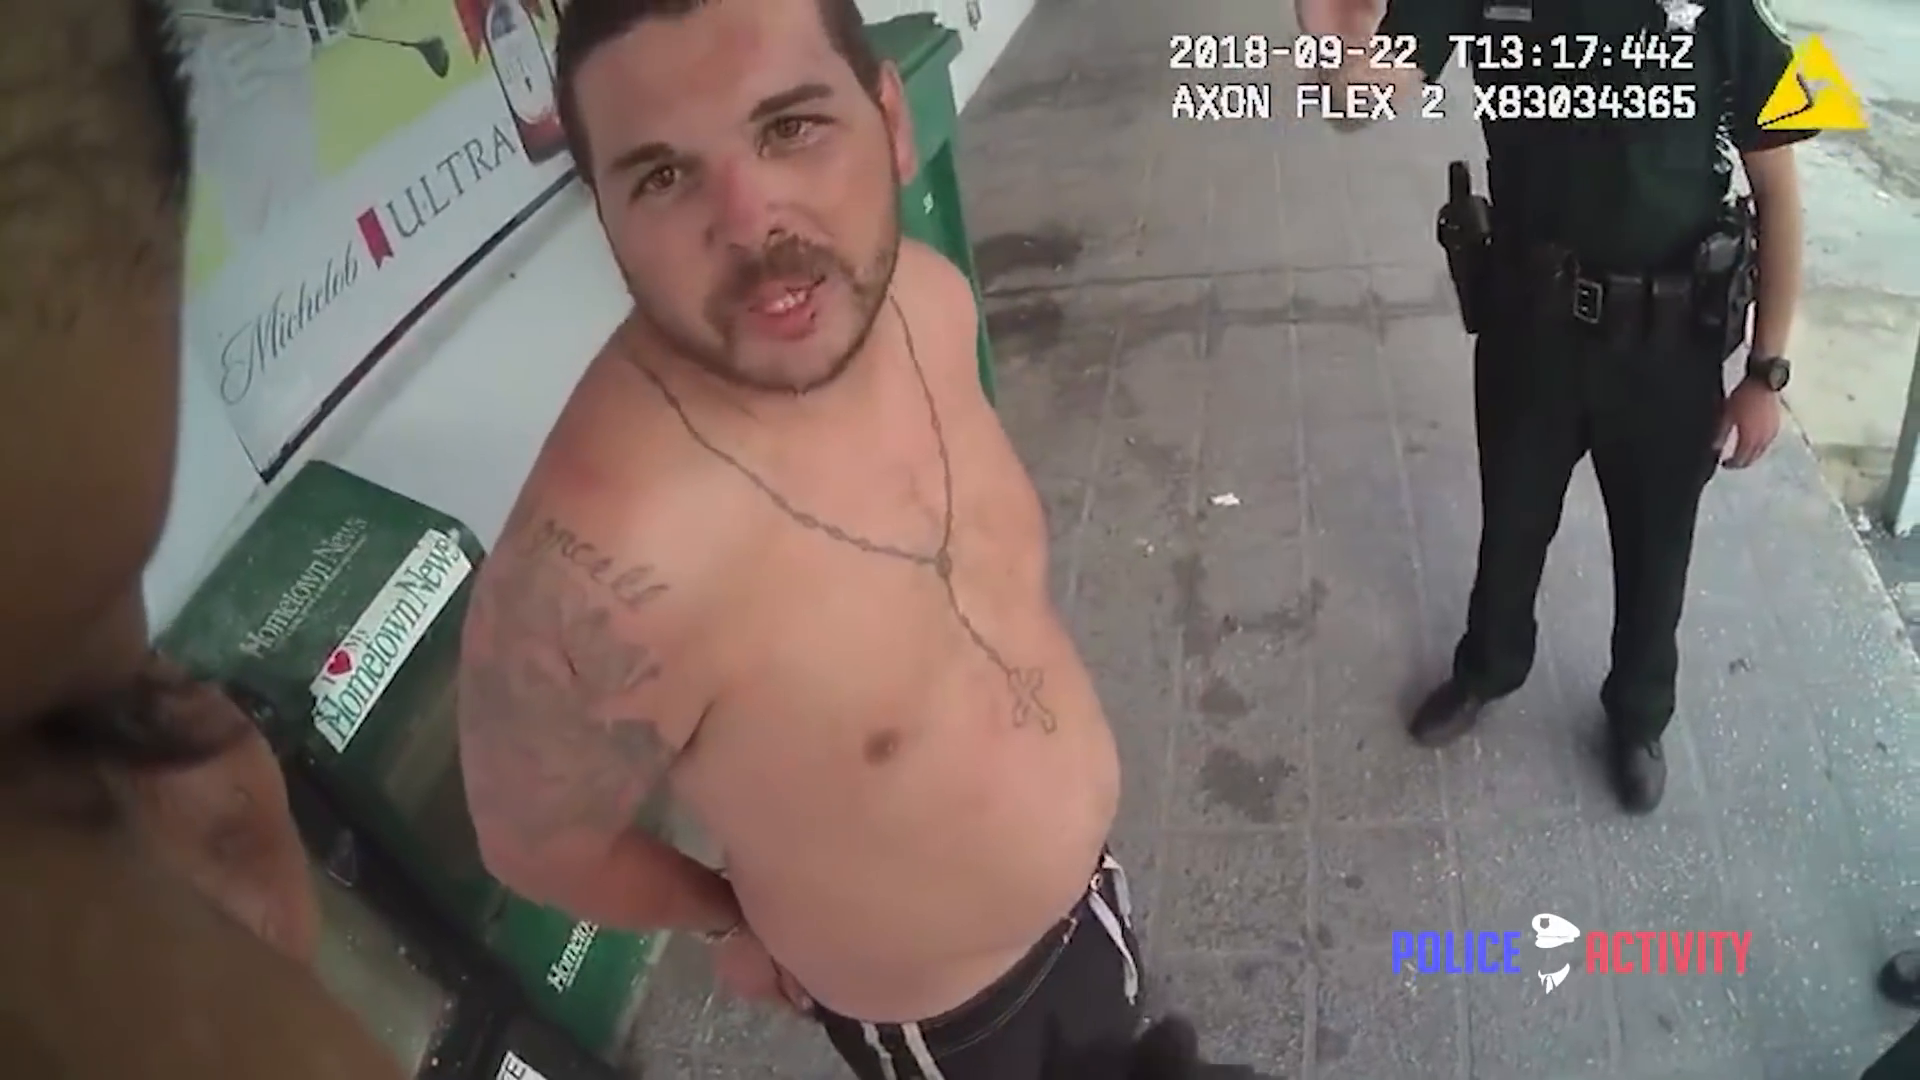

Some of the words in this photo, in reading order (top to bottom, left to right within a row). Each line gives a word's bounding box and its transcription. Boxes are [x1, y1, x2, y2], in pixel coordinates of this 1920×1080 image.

[219, 240, 360, 406] Michelob
[384, 123, 518, 241] ULTRA
[239, 559, 333, 660] Hometown
[311, 597, 420, 744] Hometown
[393, 537, 462, 612] News
